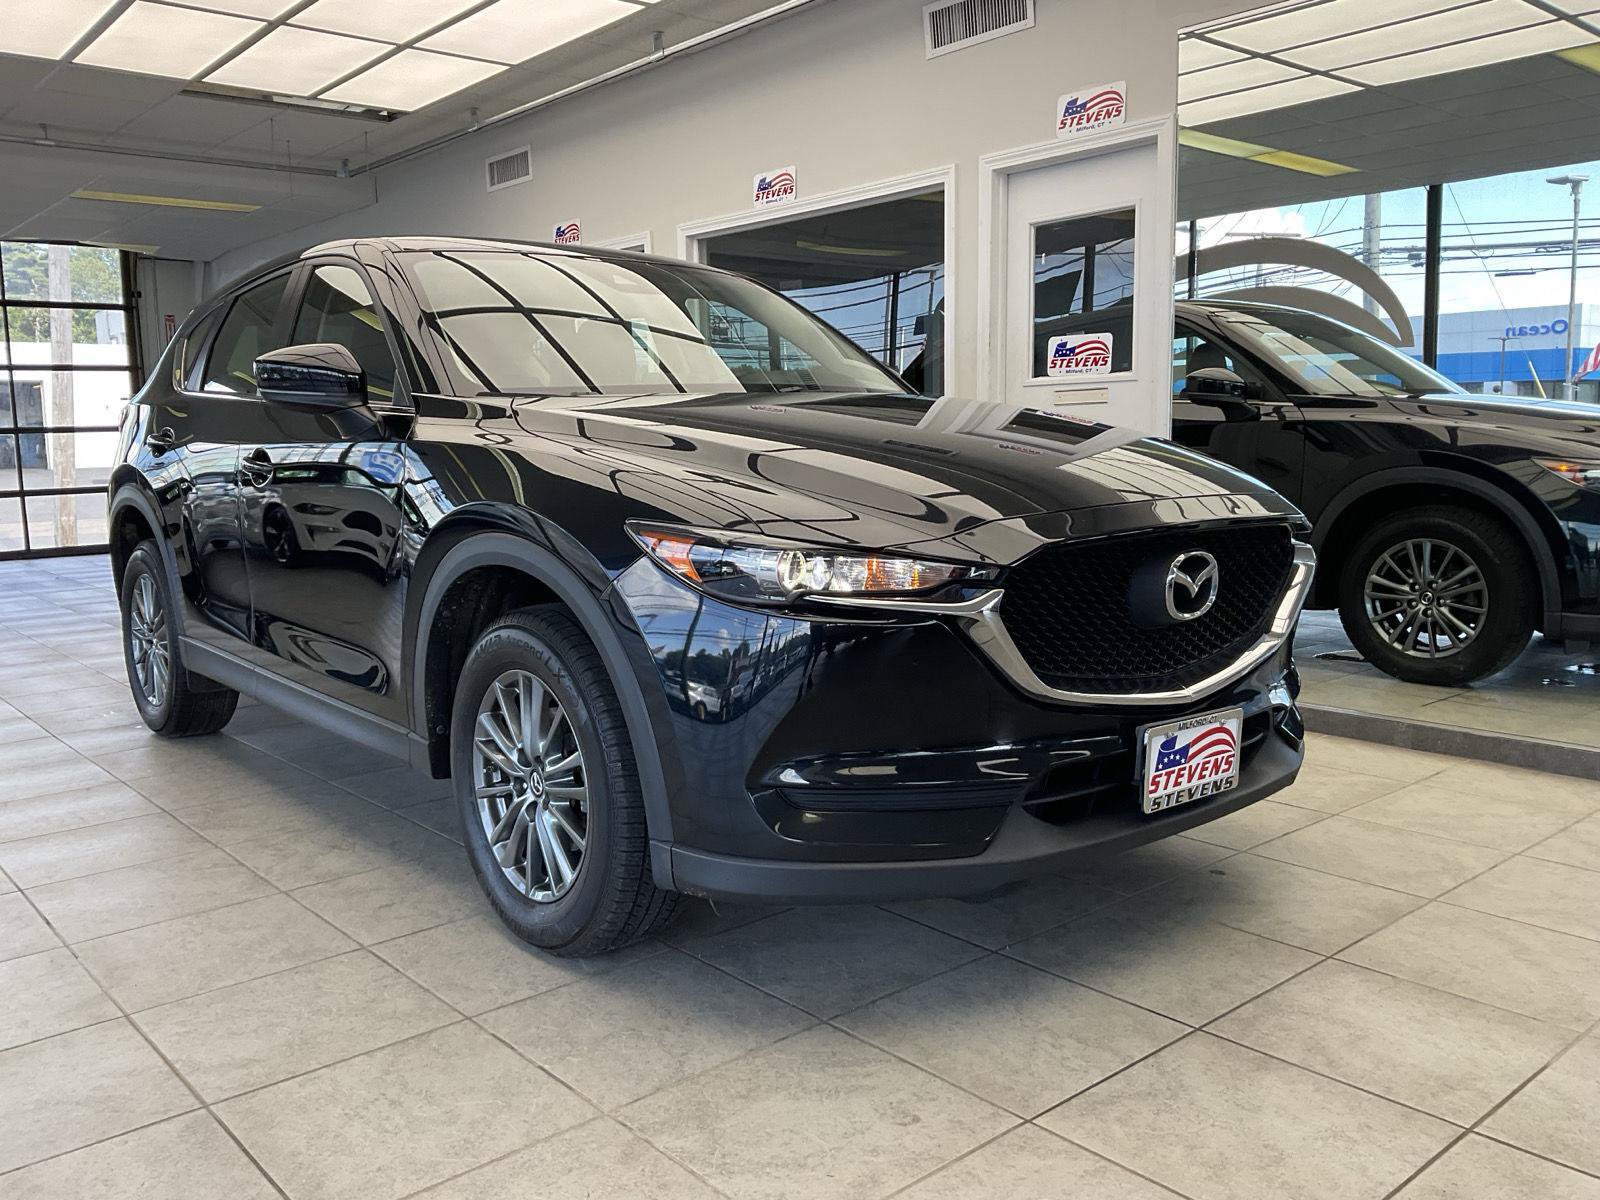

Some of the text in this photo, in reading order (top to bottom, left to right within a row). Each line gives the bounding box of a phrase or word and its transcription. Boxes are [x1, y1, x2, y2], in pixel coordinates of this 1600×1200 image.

[1059, 105, 1123, 129] STEVENS
[754, 184, 795, 202] STEVENS
[554, 233, 580, 244] STEVENS
[1049, 356, 1110, 369] STEVENS
[1148, 753, 1236, 795] STEVENS
[1150, 775, 1235, 812] STEVENS
